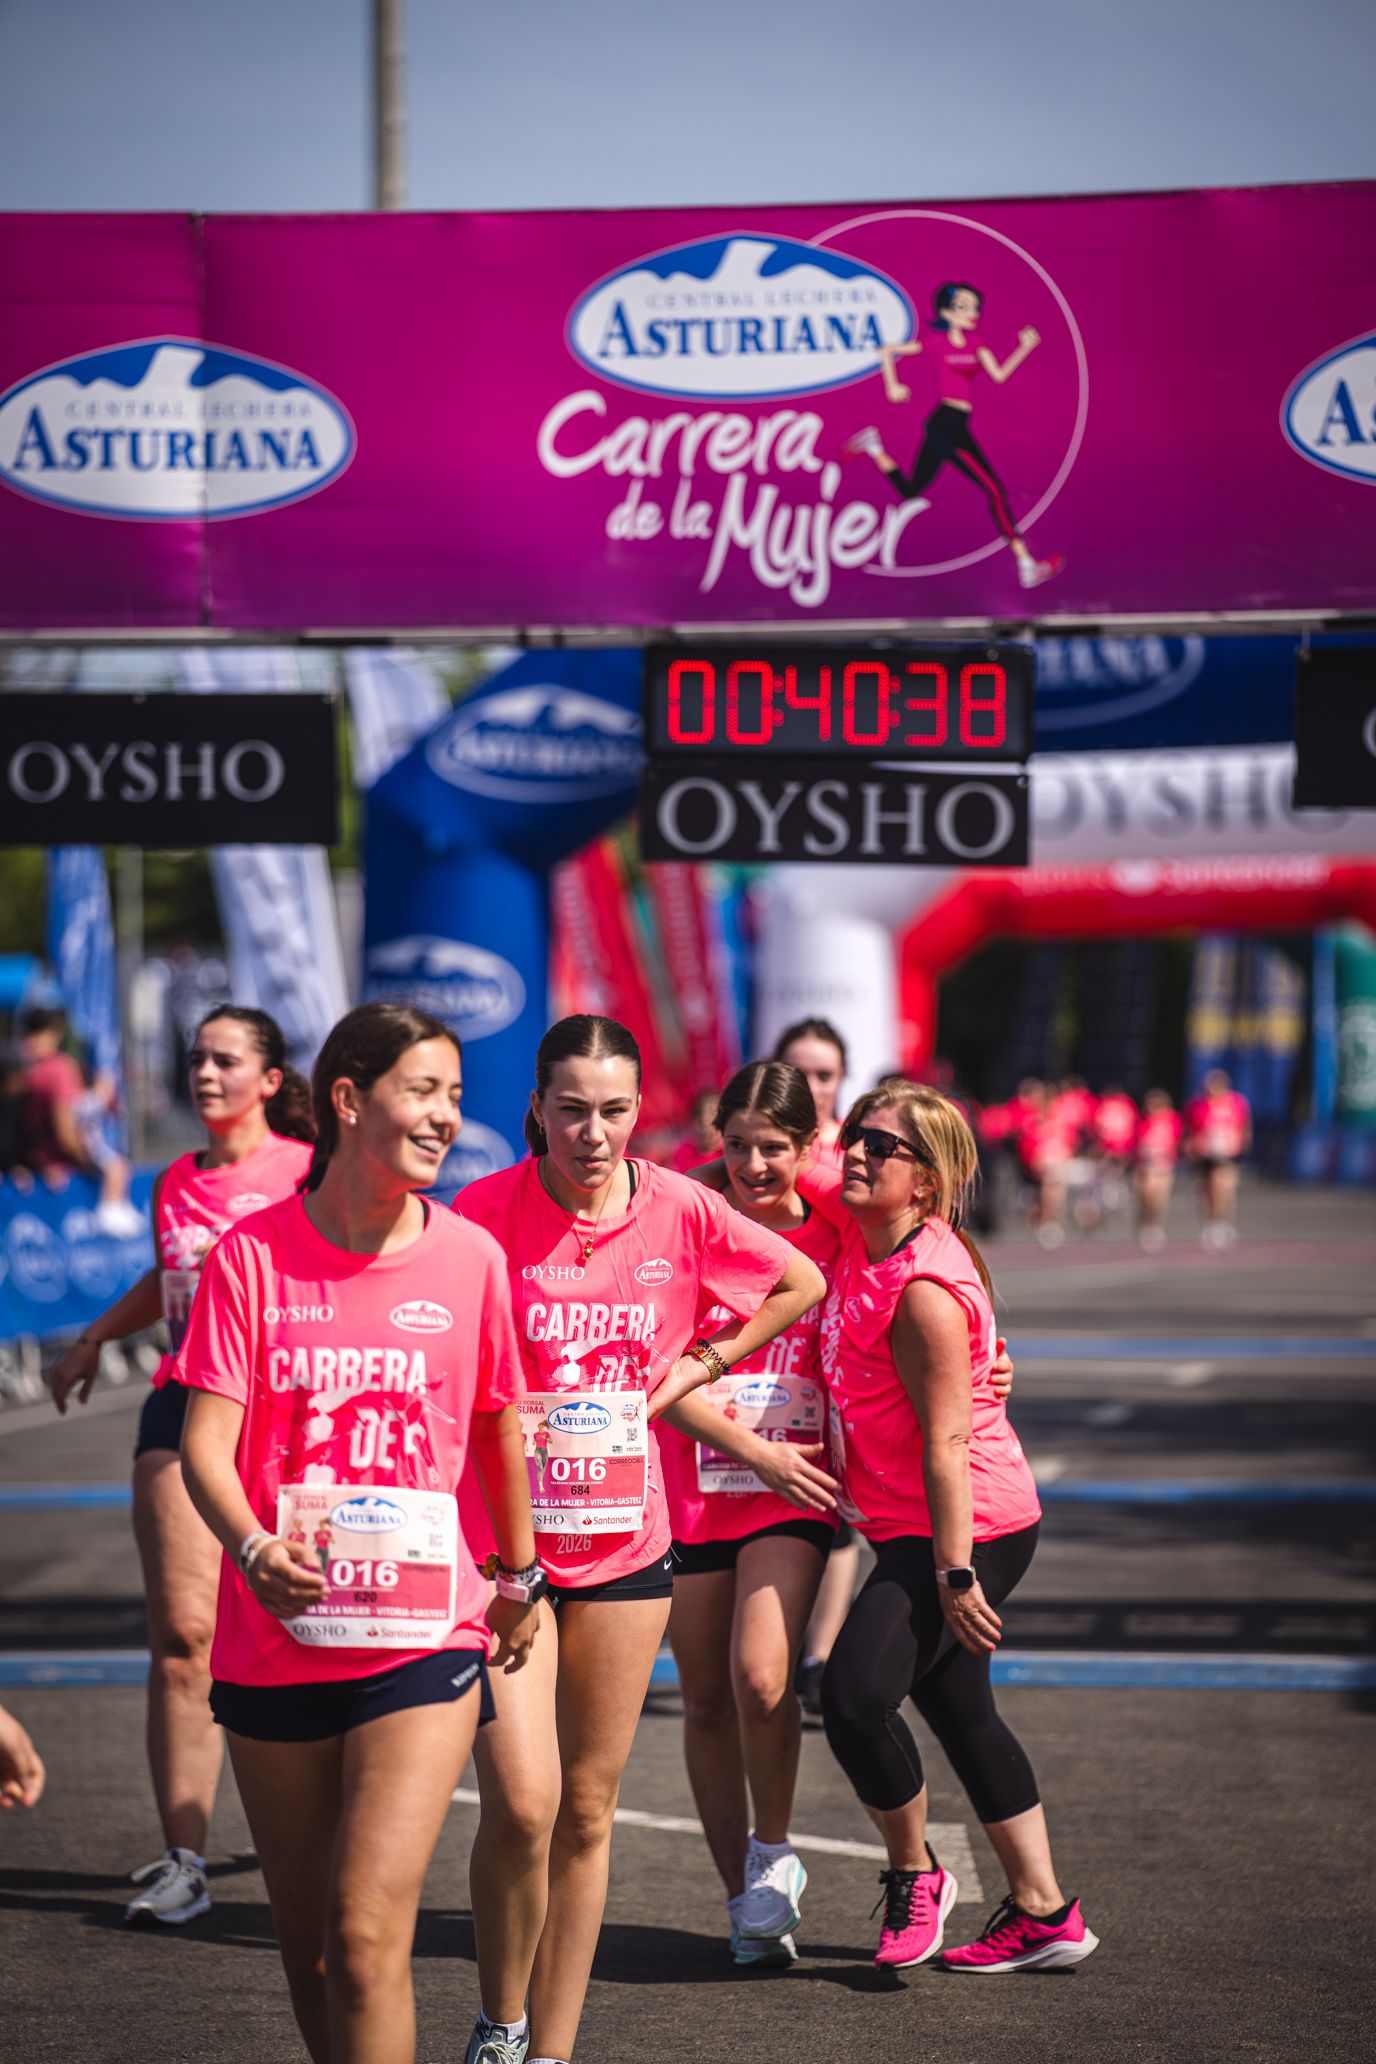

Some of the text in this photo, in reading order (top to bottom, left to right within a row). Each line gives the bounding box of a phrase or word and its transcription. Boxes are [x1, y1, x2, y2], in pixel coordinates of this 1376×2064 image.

[600, 300, 884, 359] ASTURIANA
[1315, 377, 1376, 447] A
[12, 403, 323, 472] ASTURIANA
[536, 389, 824, 479] Carrera
[605, 461, 931, 608] de la Mujer
[668, 659, 1007, 748] 00:40:38
[8, 739, 285, 803] OYSHO
[656, 776, 1015, 858] OYSHO
[522, 1265, 585, 1280] OYSHO
[263, 1304, 334, 1325] OYSHO
[516, 1405, 545, 1414] SUMA
[553, 1412, 608, 1426] ASTURIANA
[551, 1457, 607, 1482] 016
[540, 1499, 549, 1507] DE
[550, 1499, 560, 1507] LA
[561, 1498, 585, 1507] MUJER
[570, 1485, 590, 1496] 684
[594, 1515, 632, 1526] Santander
[556, 1534, 592, 1555] 2026
[331, 1559, 400, 1588] 016
[293, 1624, 347, 1638] OYSHO
